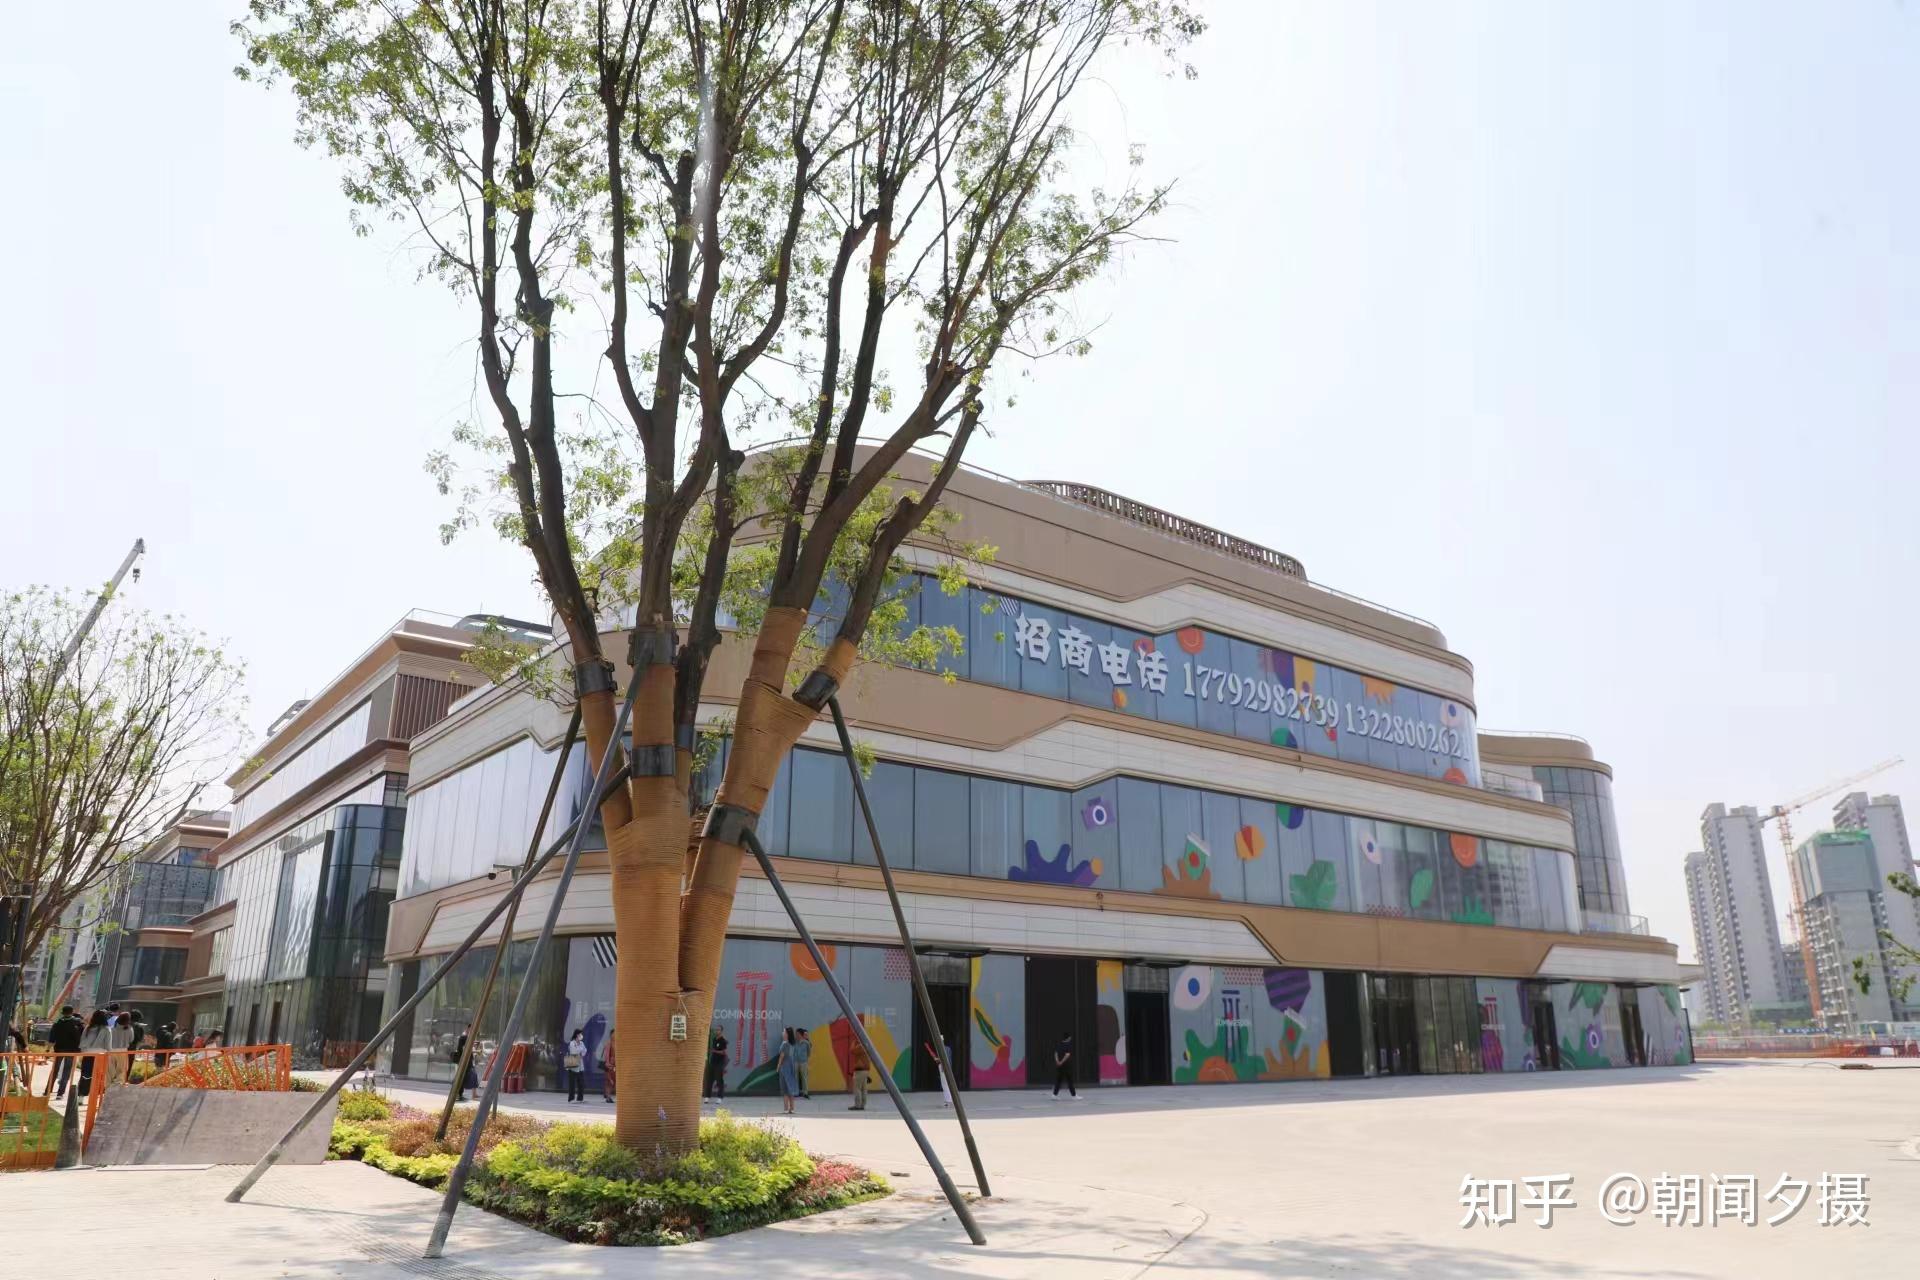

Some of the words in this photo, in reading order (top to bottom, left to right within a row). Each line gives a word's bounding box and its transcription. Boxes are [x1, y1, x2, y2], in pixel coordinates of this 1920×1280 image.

[1014, 612, 1169, 696] 招商电话
[1183, 662, 1339, 728] 17792982739
[714, 1009, 753, 1021] COMING
[755, 1009, 782, 1021] SOON
